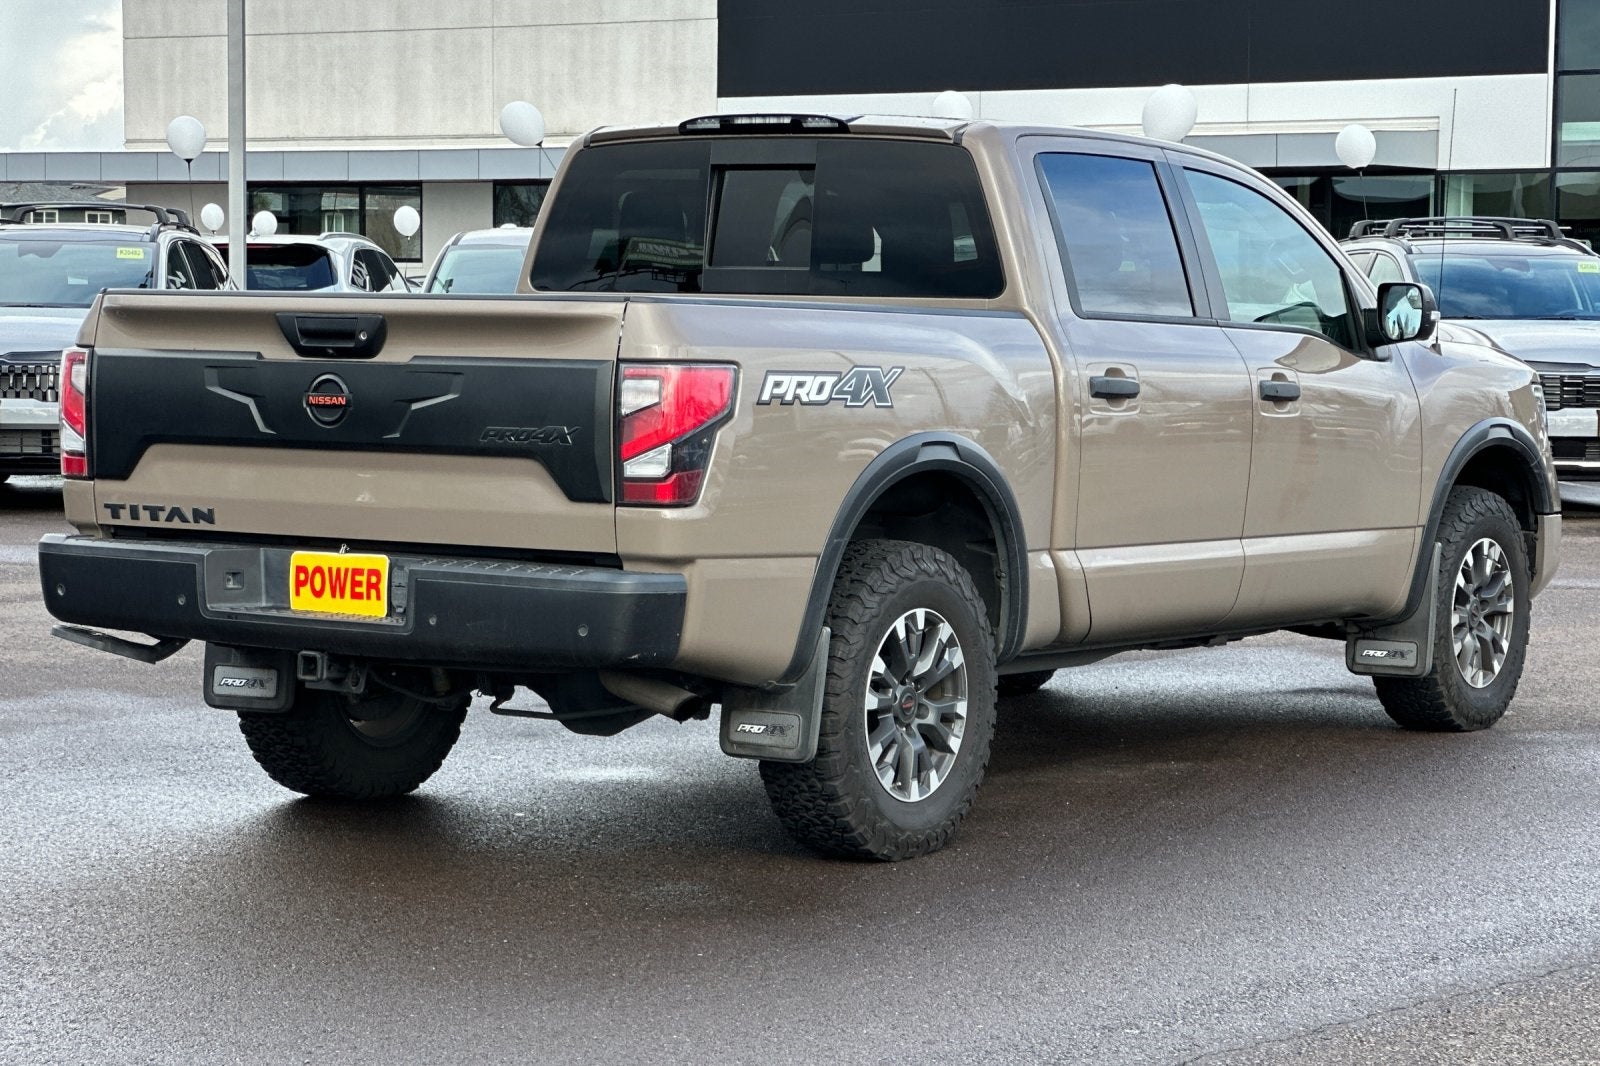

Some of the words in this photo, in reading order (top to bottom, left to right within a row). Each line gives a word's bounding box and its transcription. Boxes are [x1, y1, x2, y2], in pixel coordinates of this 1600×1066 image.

[757, 365, 905, 408] PRO4X
[308, 396, 346, 405] NISSAN
[479, 425, 581, 446] PRO4X
[104, 503, 215, 525] TITAN
[294, 566, 382, 602] POWER
